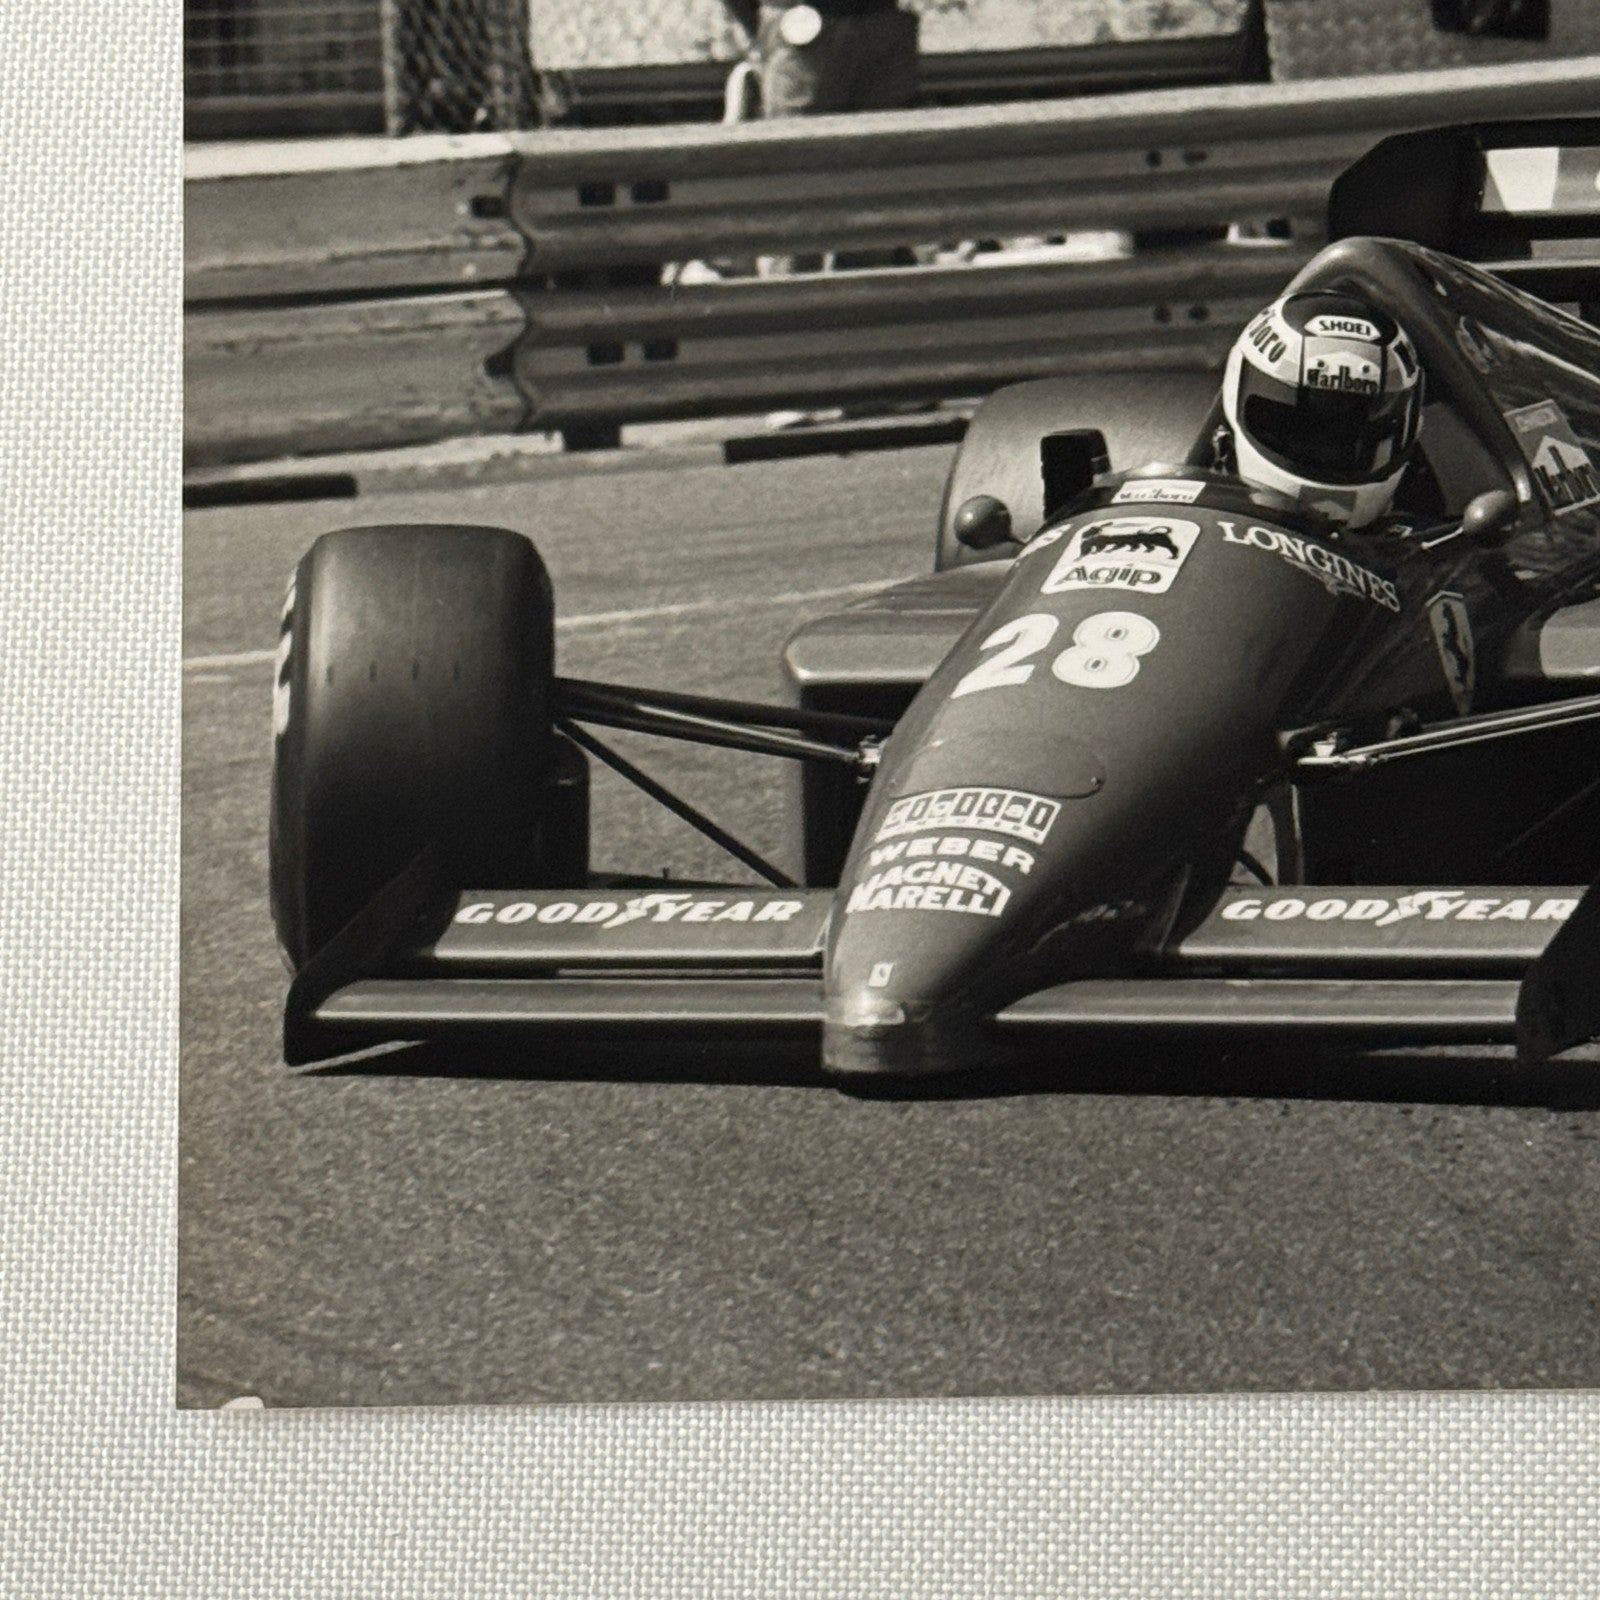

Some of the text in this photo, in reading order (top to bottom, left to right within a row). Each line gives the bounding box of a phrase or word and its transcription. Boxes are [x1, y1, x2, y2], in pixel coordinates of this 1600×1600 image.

[1319, 320, 1372, 337] SHOEI
[1056, 563, 1162, 587] Agip
[1217, 521, 1401, 613] LONGINES
[950, 611, 1160, 699] 28
[870, 837, 1036, 874] WEBER
[454, 893, 802, 929] GOODYEAR
